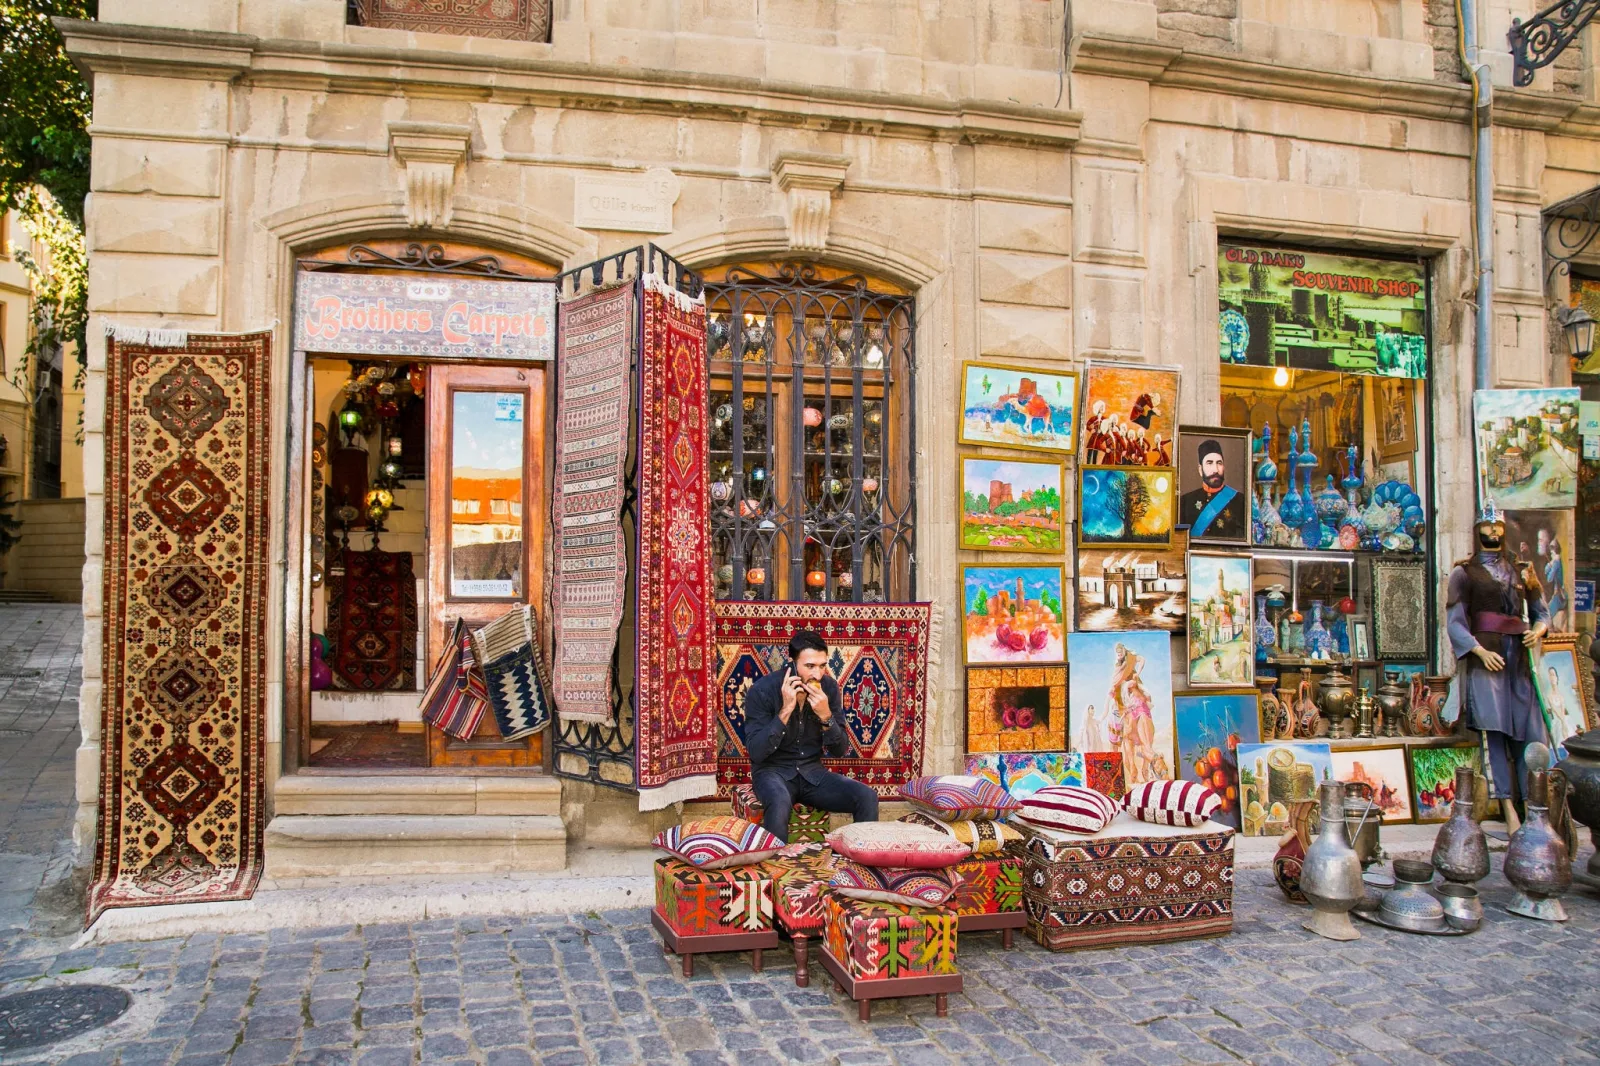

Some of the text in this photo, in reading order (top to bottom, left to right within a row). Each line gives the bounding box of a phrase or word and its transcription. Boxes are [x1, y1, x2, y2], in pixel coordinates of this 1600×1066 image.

[1225, 248, 1305, 269] OLD BAKU
[1292, 270, 1420, 298] SOUVENIR SHOP
[304, 294, 548, 345] Brothers Carpets
